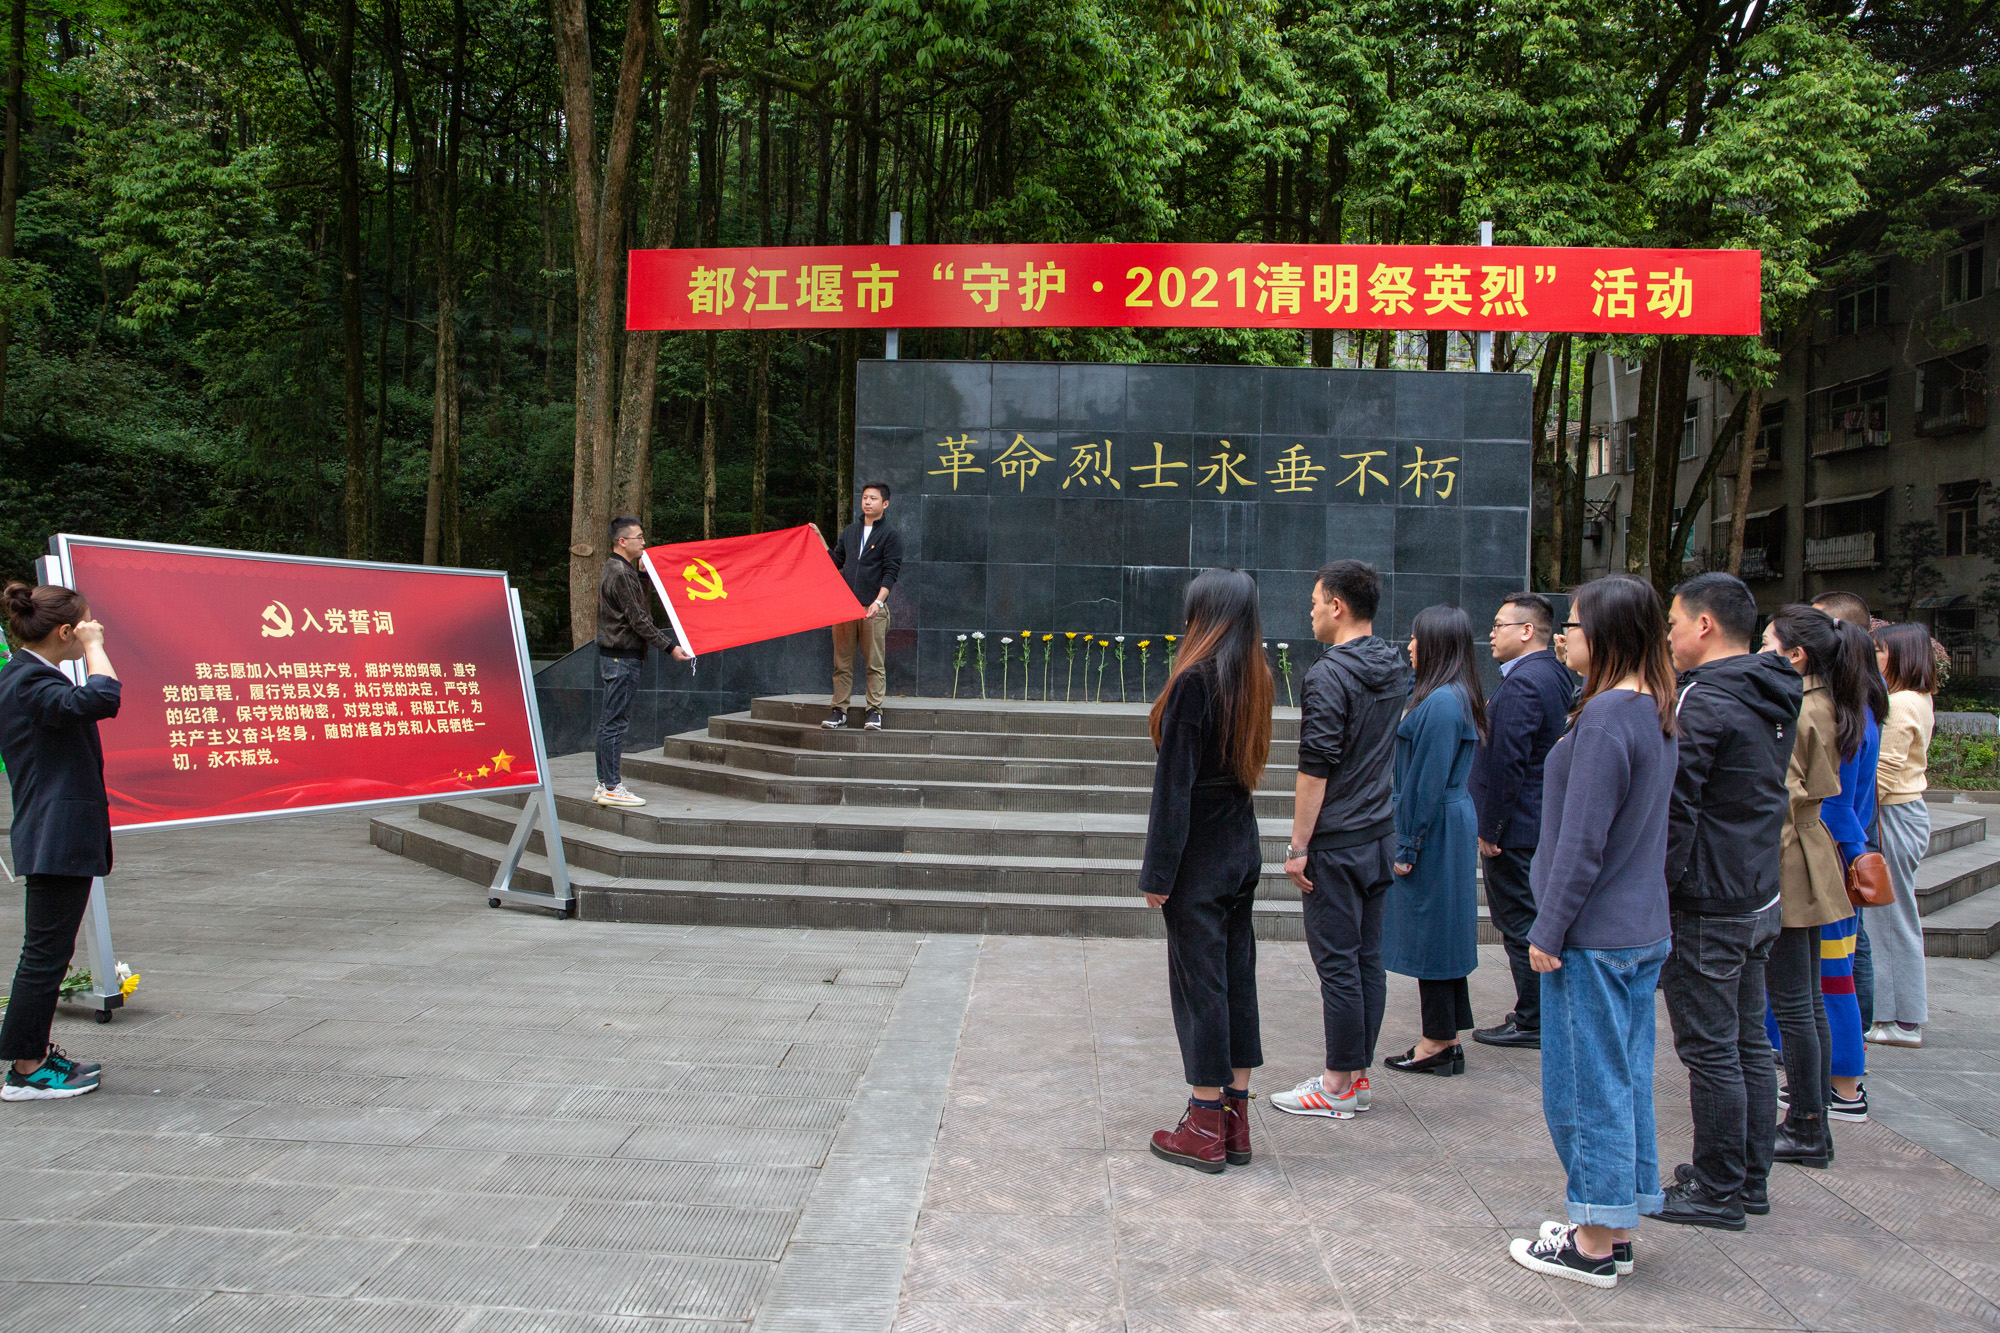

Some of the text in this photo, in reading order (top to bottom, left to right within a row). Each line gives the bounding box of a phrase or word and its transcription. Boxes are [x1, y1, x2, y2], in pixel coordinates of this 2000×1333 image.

[687, 262, 900, 316] 都江堰市
[1590, 266, 1693, 320] 活动
[927, 433, 1459, 499] 革命烈士永垂不朽
[300, 607, 395, 635] 入党誓词
